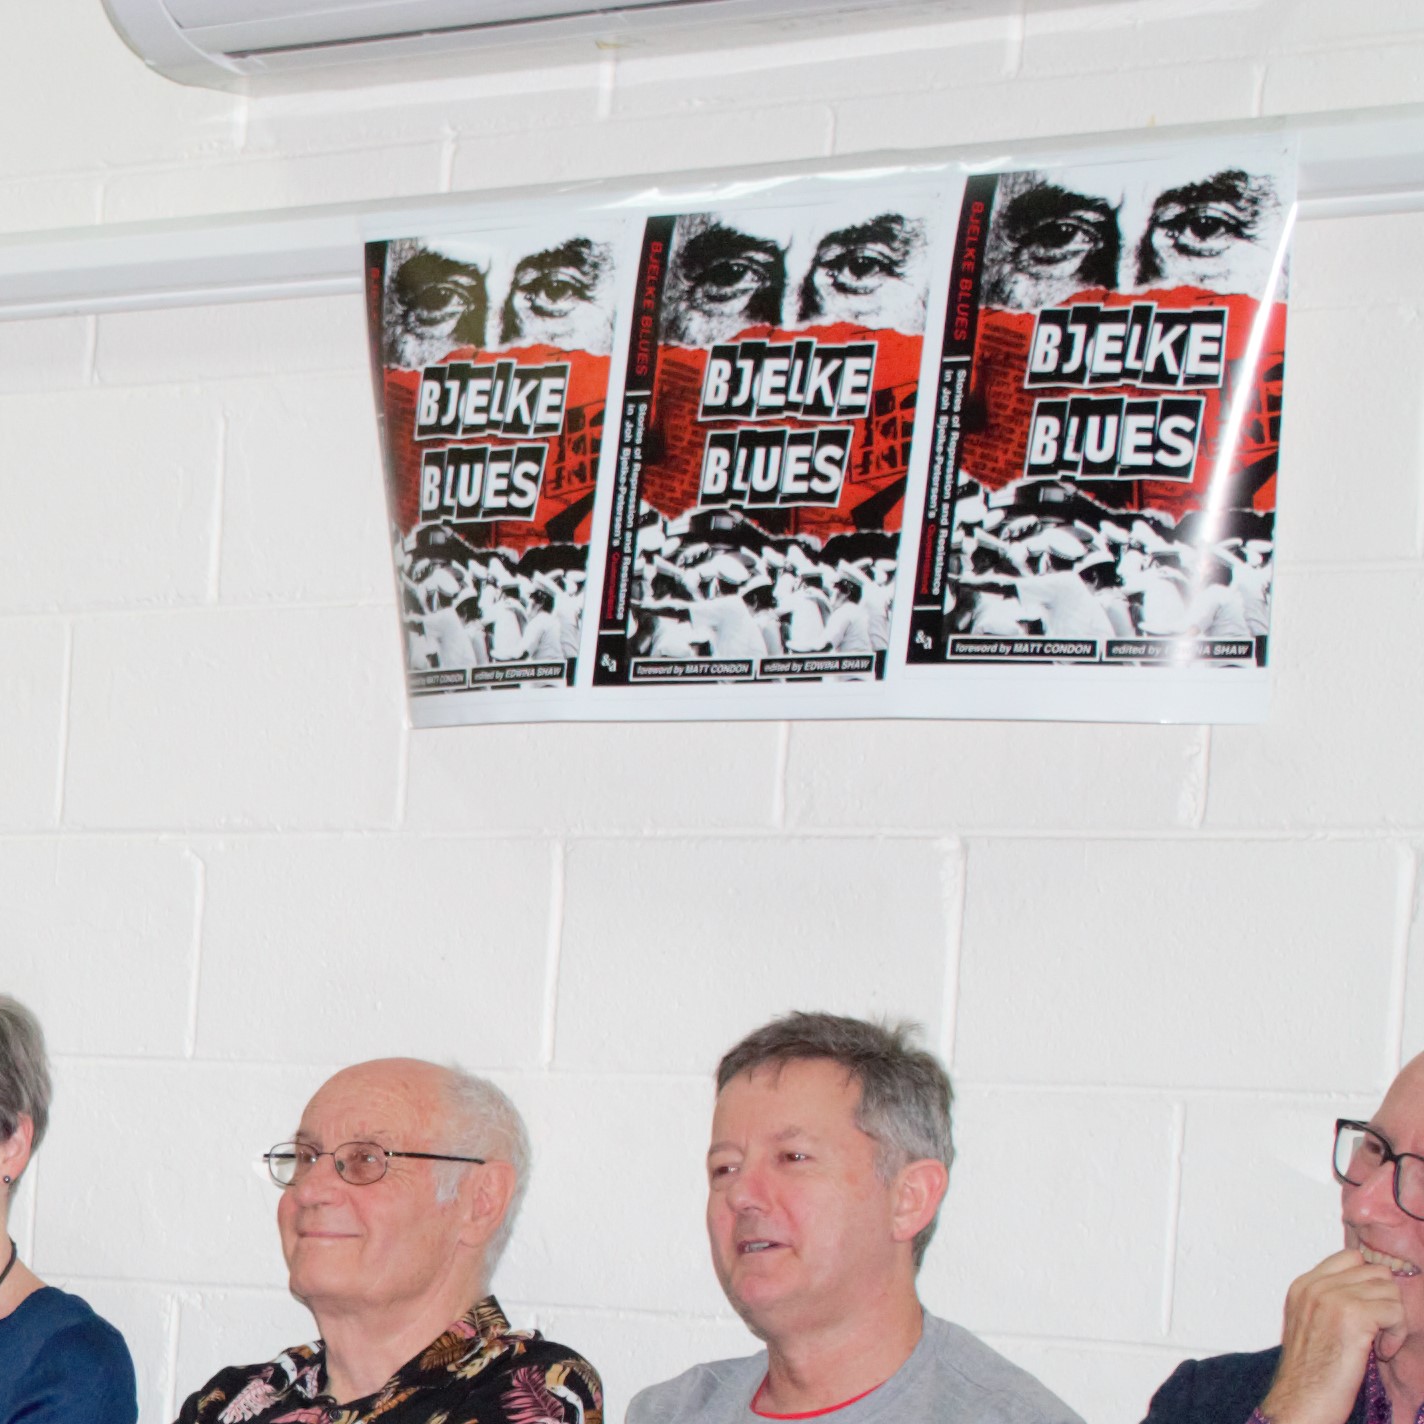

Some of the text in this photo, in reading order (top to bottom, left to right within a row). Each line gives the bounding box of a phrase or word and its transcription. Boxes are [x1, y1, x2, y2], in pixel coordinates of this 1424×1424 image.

[954, 201, 984, 341] BJELKE BLUES
[635, 241, 663, 376] BJELKE BLUES
[1030, 323, 1222, 376] BJELKE
[418, 377, 565, 427] BJELKE
[703, 357, 872, 408] BJELKE
[953, 369, 967, 413] Stories
[634, 403, 648, 445] Stories
[1029, 415, 1197, 468] BLUES
[422, 461, 540, 511] BLUES
[702, 445, 845, 494] BLUES
[943, 430, 960, 500] Repression
[626, 462, 642, 528] Repression
[940, 502, 950, 526] and
[623, 531, 633, 554] and
[932, 529, 949, 596] Resistance
[616, 555, 632, 620] Resistance
[637, 663, 749, 677] foreword by MATT CONDON
[763, 662, 790, 673] edited
[791, 662, 802, 674] by
[955, 642, 1092, 656] foreword by MATT CONDON
